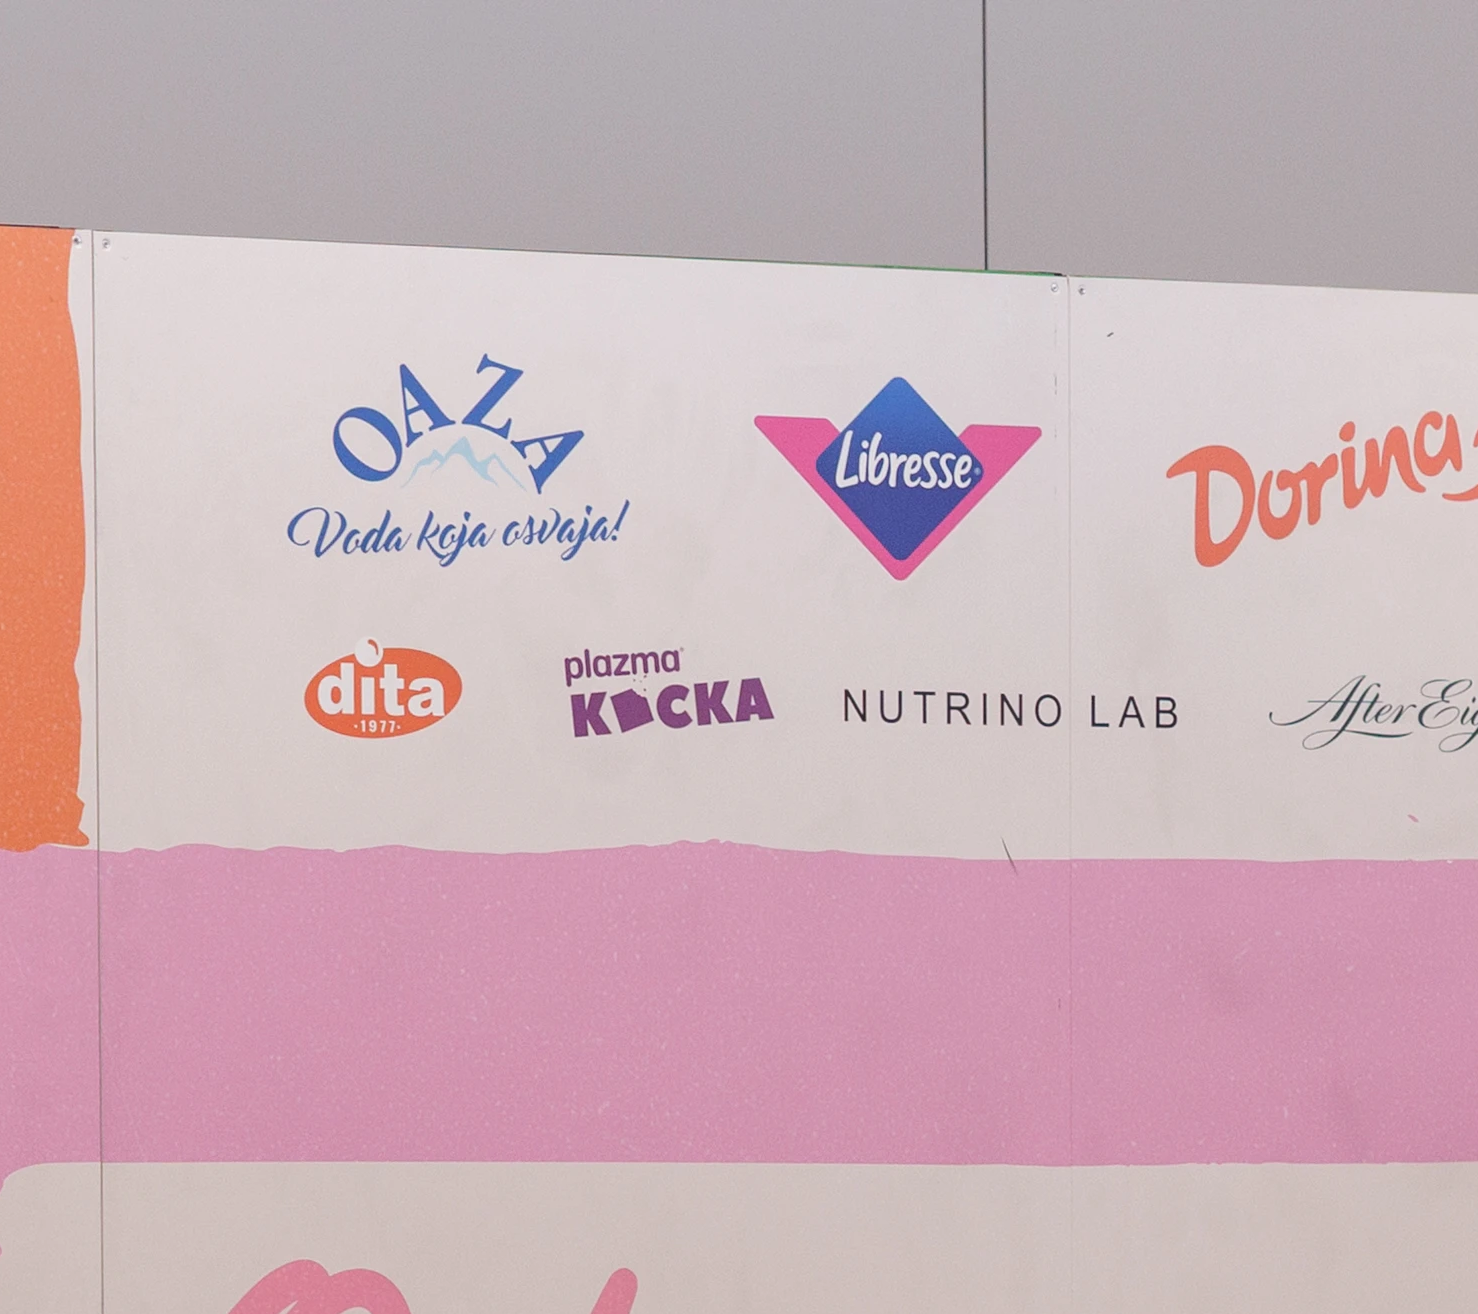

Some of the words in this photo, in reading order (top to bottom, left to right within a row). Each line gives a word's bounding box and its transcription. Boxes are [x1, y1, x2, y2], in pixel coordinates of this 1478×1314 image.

[331, 352, 585, 495] OAZA
[834, 430, 973, 489] Libresse
[1165, 410, 1464, 568] Dorina
[286, 505, 413, 559] Voda
[416, 508, 497, 568] koja
[501, 498, 631, 562] osvaja!
[317, 662, 446, 718] dita
[564, 649, 680, 687] plazma
[360, 720, 397, 733] 1977
[843, 689, 1063, 728] NUTRINO
[1089, 695, 1179, 729] LAB
[1268, 674, 1416, 751] After
